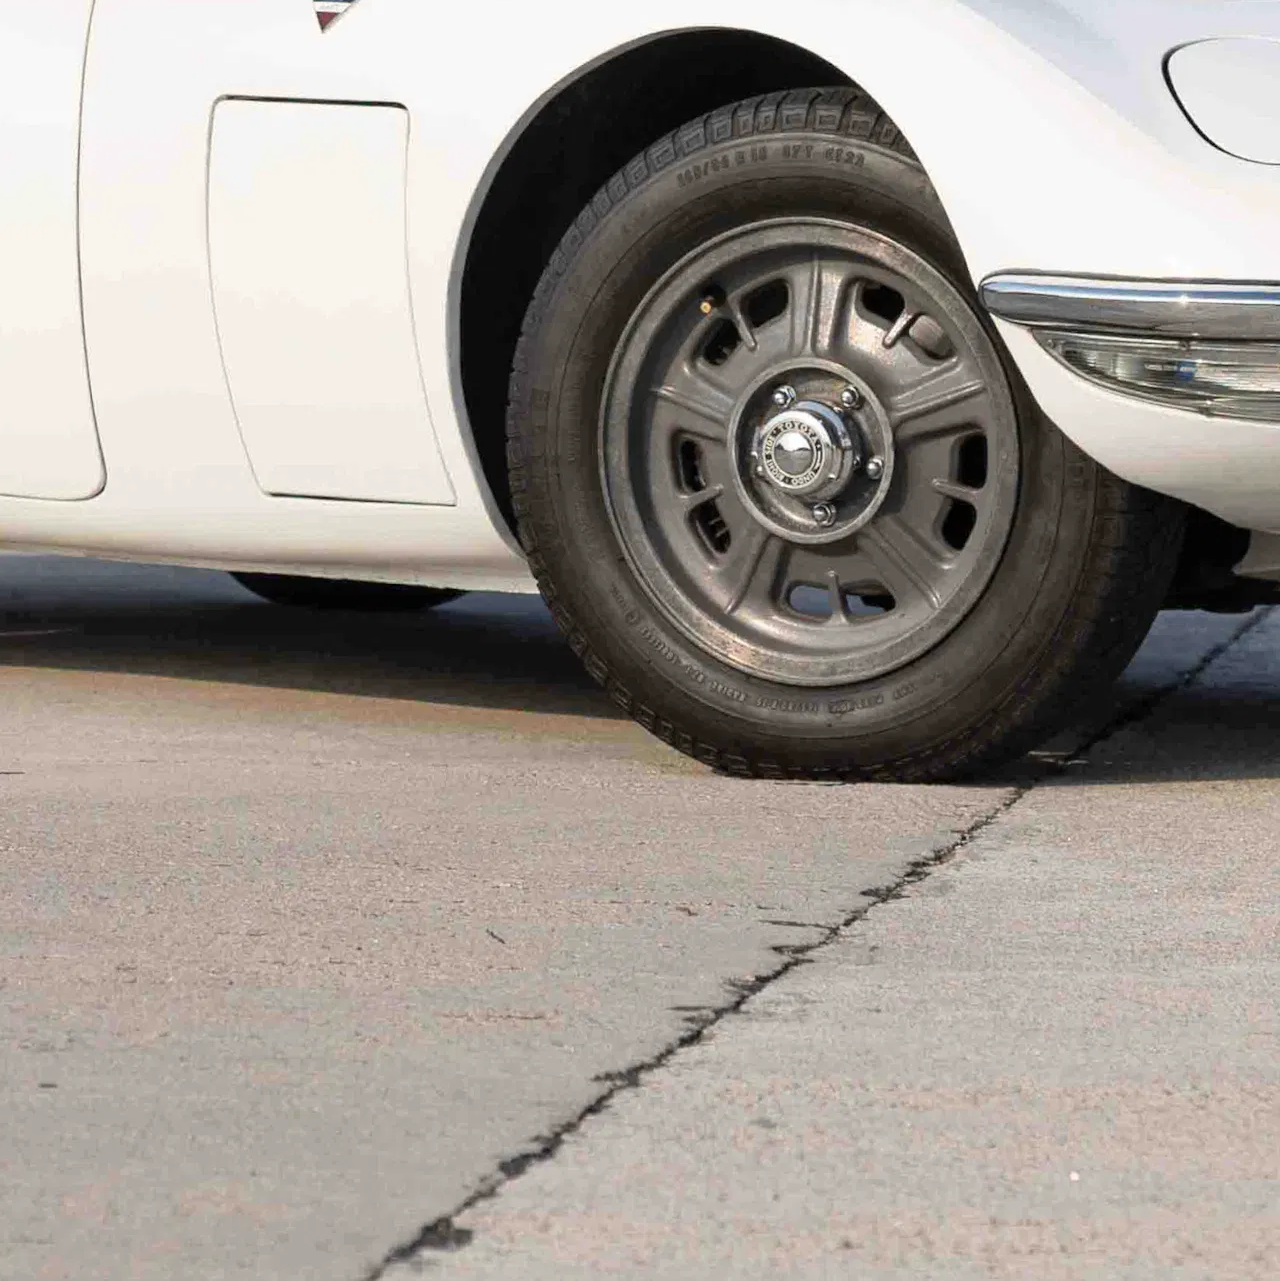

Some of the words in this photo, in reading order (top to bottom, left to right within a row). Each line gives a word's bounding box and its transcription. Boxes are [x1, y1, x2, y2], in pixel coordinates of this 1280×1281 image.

[777, 421, 818, 443] TOYOTA
[766, 459, 785, 482] RIGHT
[791, 470, 816, 486] UNDO
